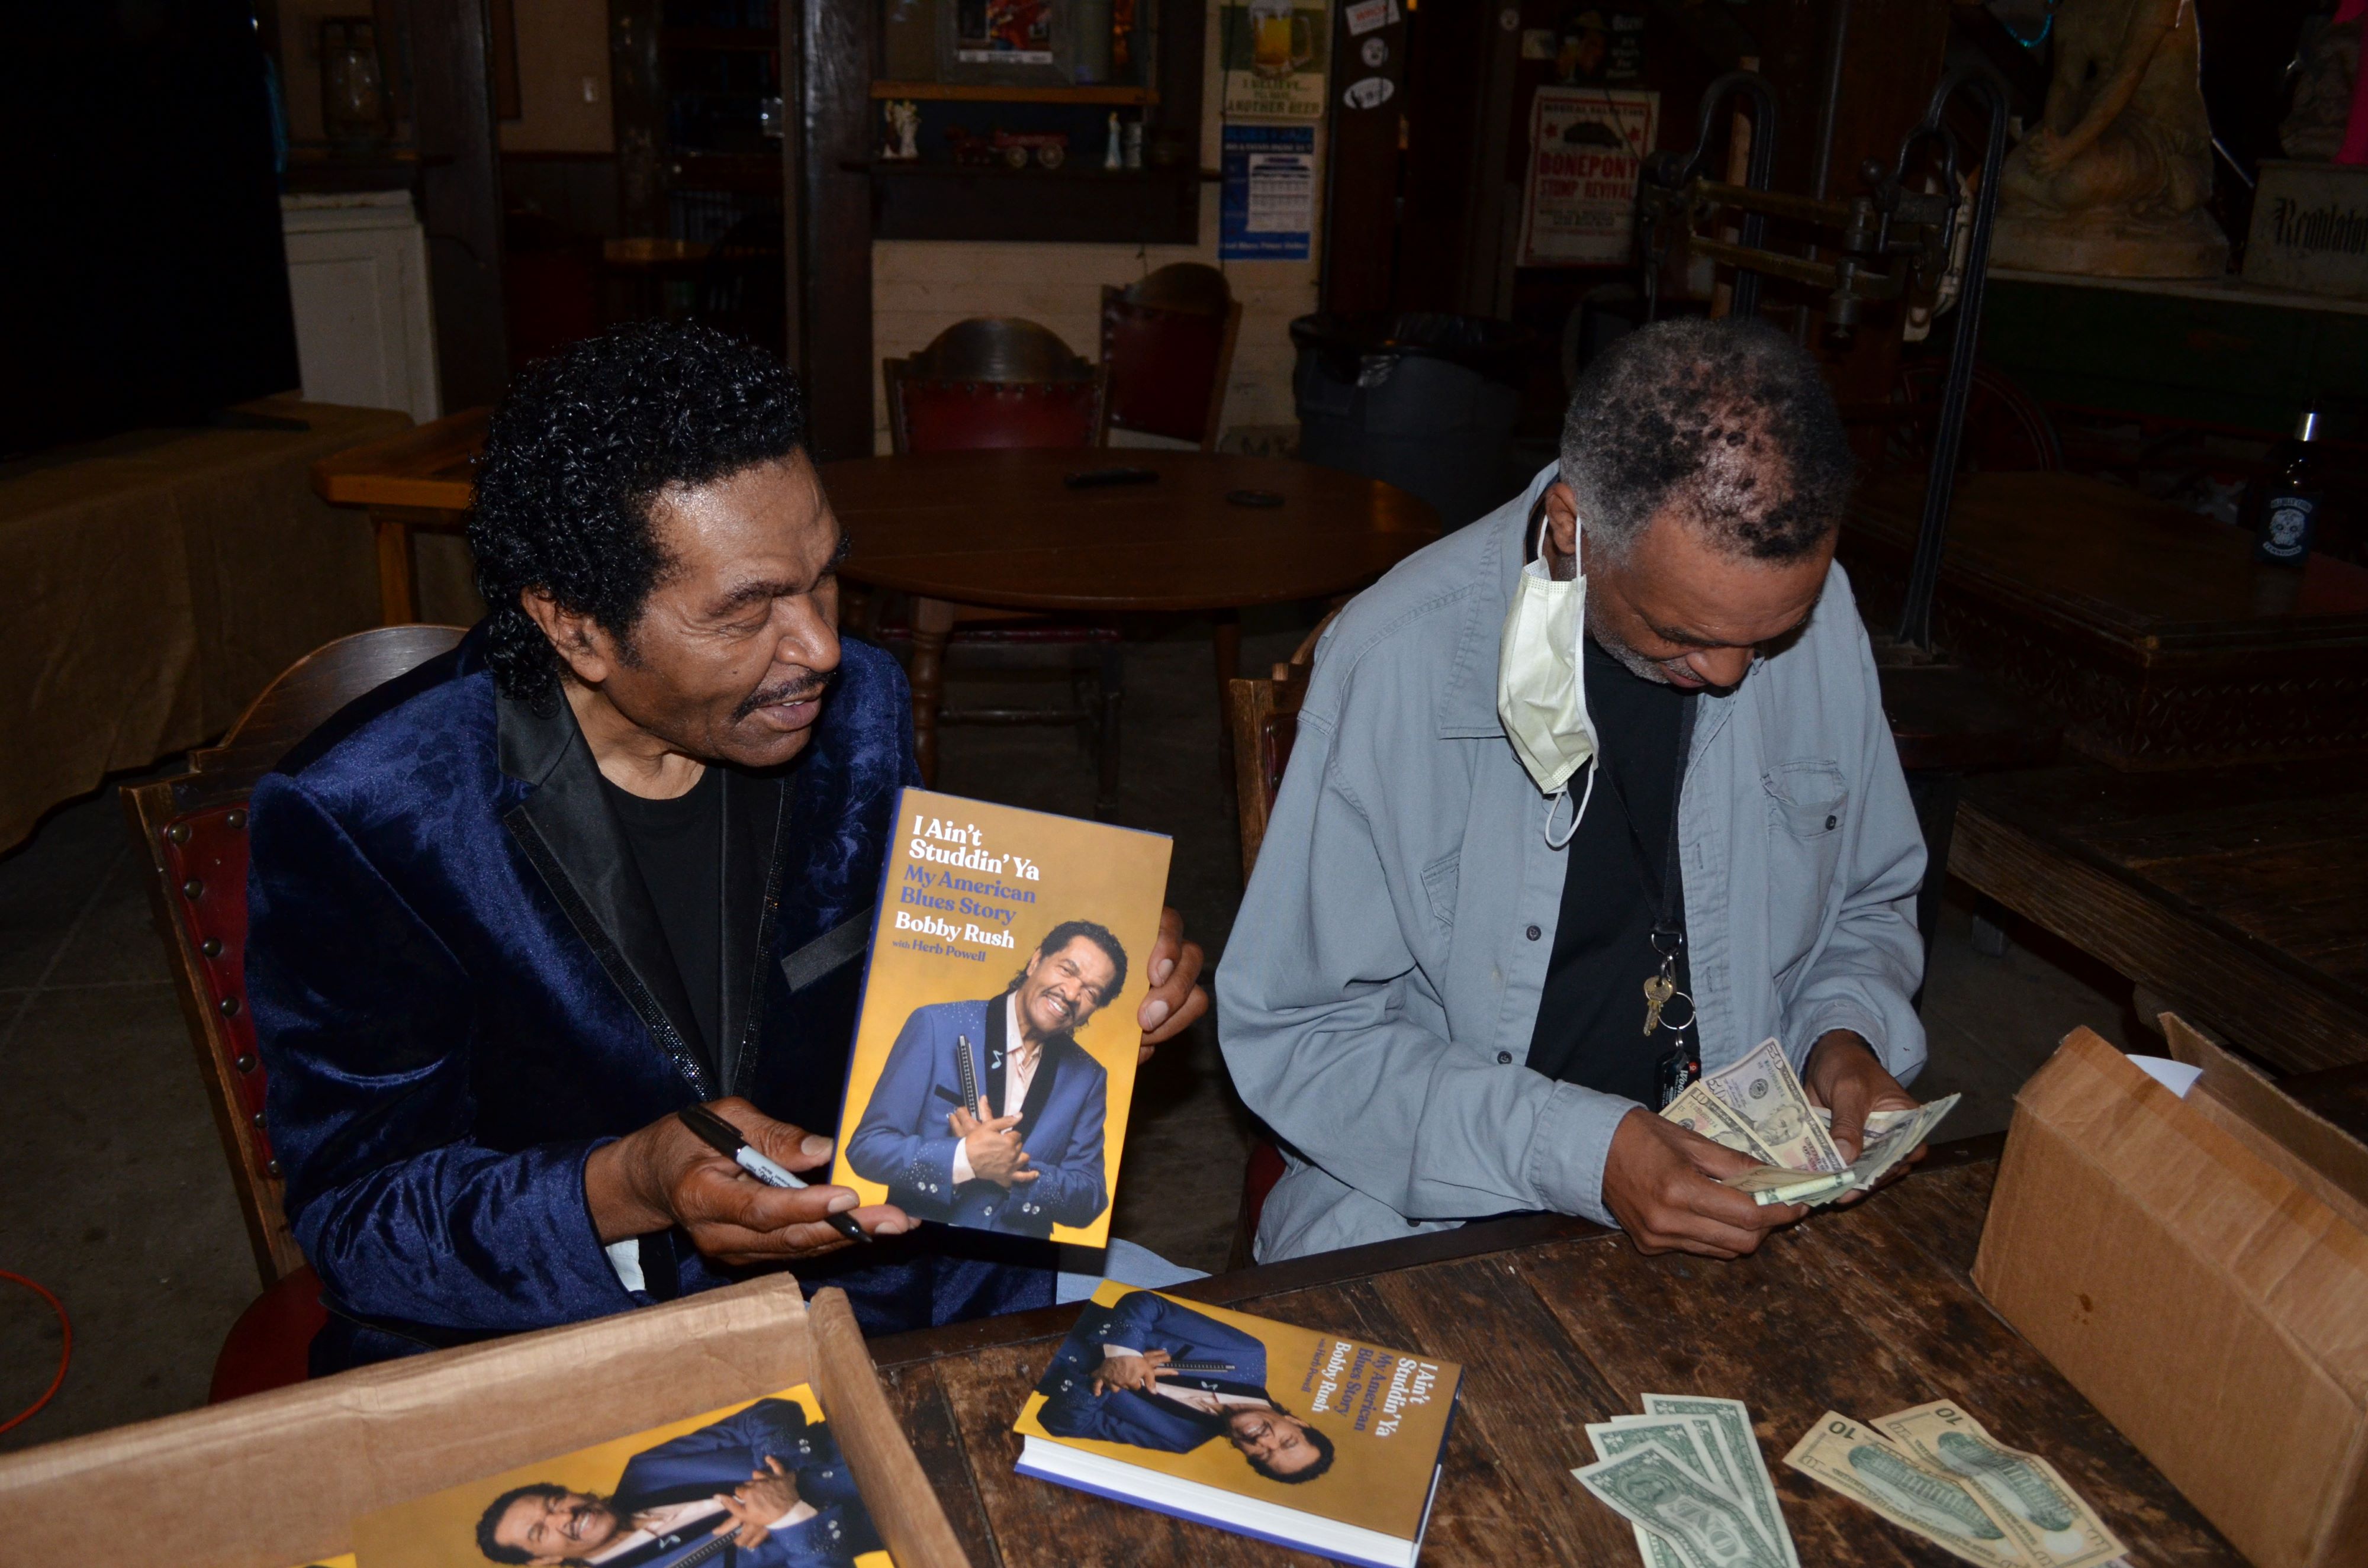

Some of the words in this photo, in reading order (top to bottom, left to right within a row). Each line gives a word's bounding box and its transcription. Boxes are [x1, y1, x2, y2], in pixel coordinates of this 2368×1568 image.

[912, 815, 924, 835] I
[924, 818, 982, 846] Ain't
[909, 839, 1009, 874] Studdin'
[1012, 857, 1040, 881] Ya
[903, 864, 936, 887] My
[938, 871, 1036, 903] American
[900, 886, 955, 911] Blues
[959, 897, 1016, 925] Story
[895, 911, 961, 942] Bobby
[964, 924, 1015, 948] Rush
[892, 939, 910, 950] with
[912, 939, 943, 955] Herb
[945, 946, 986, 962] Powell
[1678, 1069, 1688, 1095] Woo
[1311, 1348, 1326, 1367] Herb
[1321, 1341, 1352, 1381] Bobby
[1350, 1347, 1374, 1380] Blues
[1372, 1351, 1394, 1372] My
[1420, 1361, 1439, 1371] I
[1301, 1367, 1319, 1393] Powell
[1311, 1380, 1338, 1413] Rush
[1383, 1357, 1417, 1419] Studdin'
[1409, 1371, 1436, 1405] Ain't
[1333, 1381, 1362, 1417] Story
[1354, 1371, 1386, 1431] American
[1375, 1420, 1399, 1437] Ya
[1828, 1421, 1855, 1441] 10
[1935, 1406, 1964, 1426] 10
